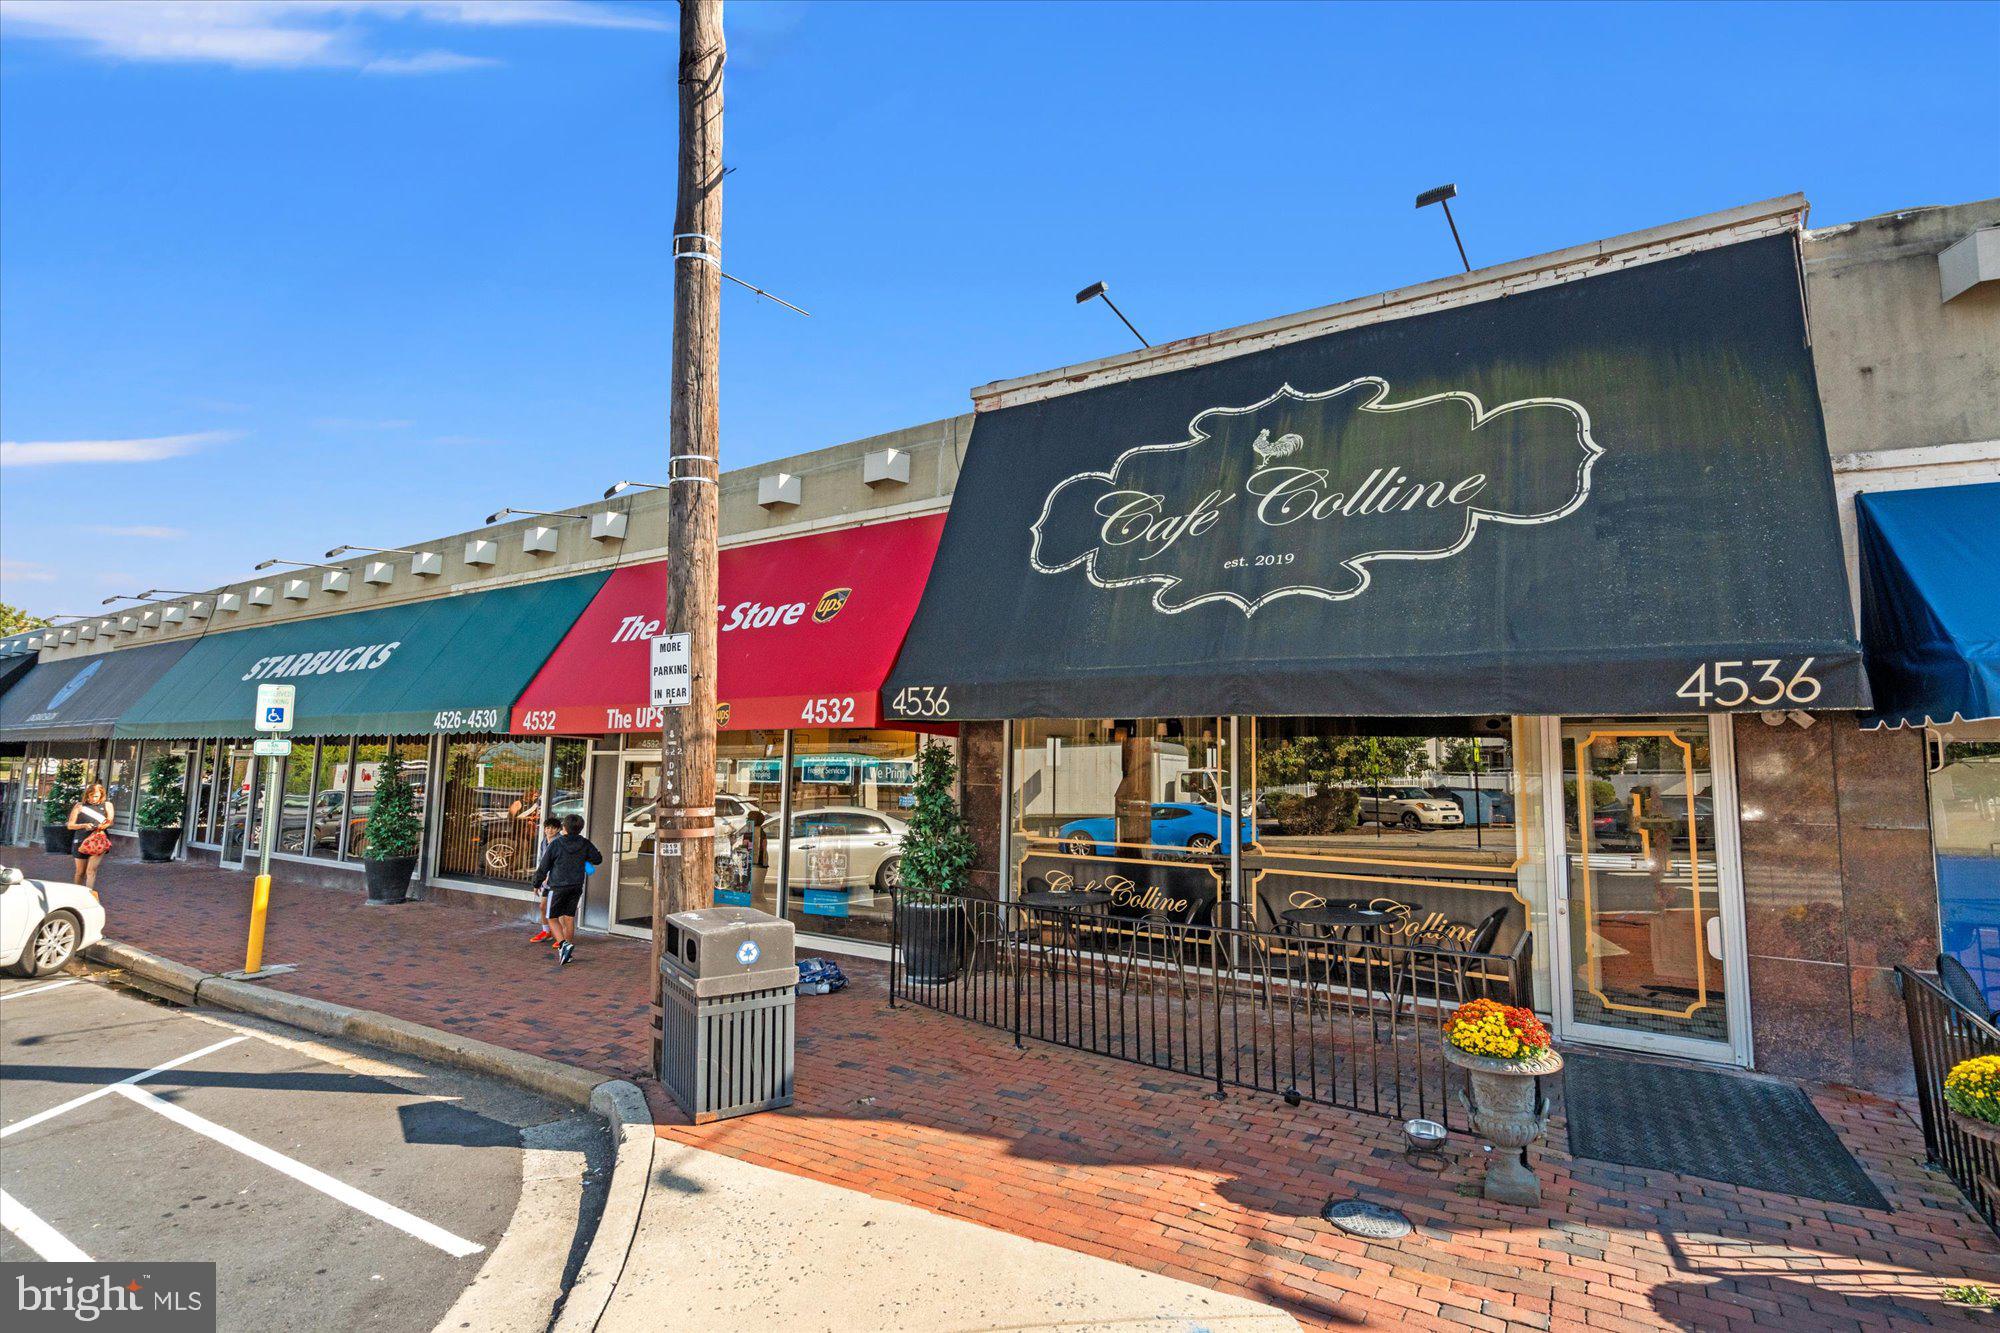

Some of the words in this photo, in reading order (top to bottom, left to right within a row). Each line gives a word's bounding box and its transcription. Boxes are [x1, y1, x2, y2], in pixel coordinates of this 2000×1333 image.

[1095, 490, 1235, 560] Café
[1246, 466, 1487, 526] Colline
[1223, 556, 1249, 569] est.
[1254, 553, 1295, 567] 2019
[819, 598, 844, 619] ups
[611, 615, 660, 643] The
[721, 601, 806, 632] Store
[659, 641, 682, 653] MORE
[242, 642, 401, 681] STARBUCKS
[653, 664, 688, 676] PARKING
[1676, 657, 1822, 707] 4536
[654, 689, 663, 699] IN
[665, 687, 687, 698] REAR
[892, 686, 950, 716] 4536
[433, 709, 497, 729] 4526-4530
[522, 710, 557, 731] 4532
[607, 708, 632, 729] The
[635, 707, 664, 728] UPS
[801, 697, 855, 724] 4532
[885, 767, 906, 780] Print
[1105, 875, 1188, 912] Colline
